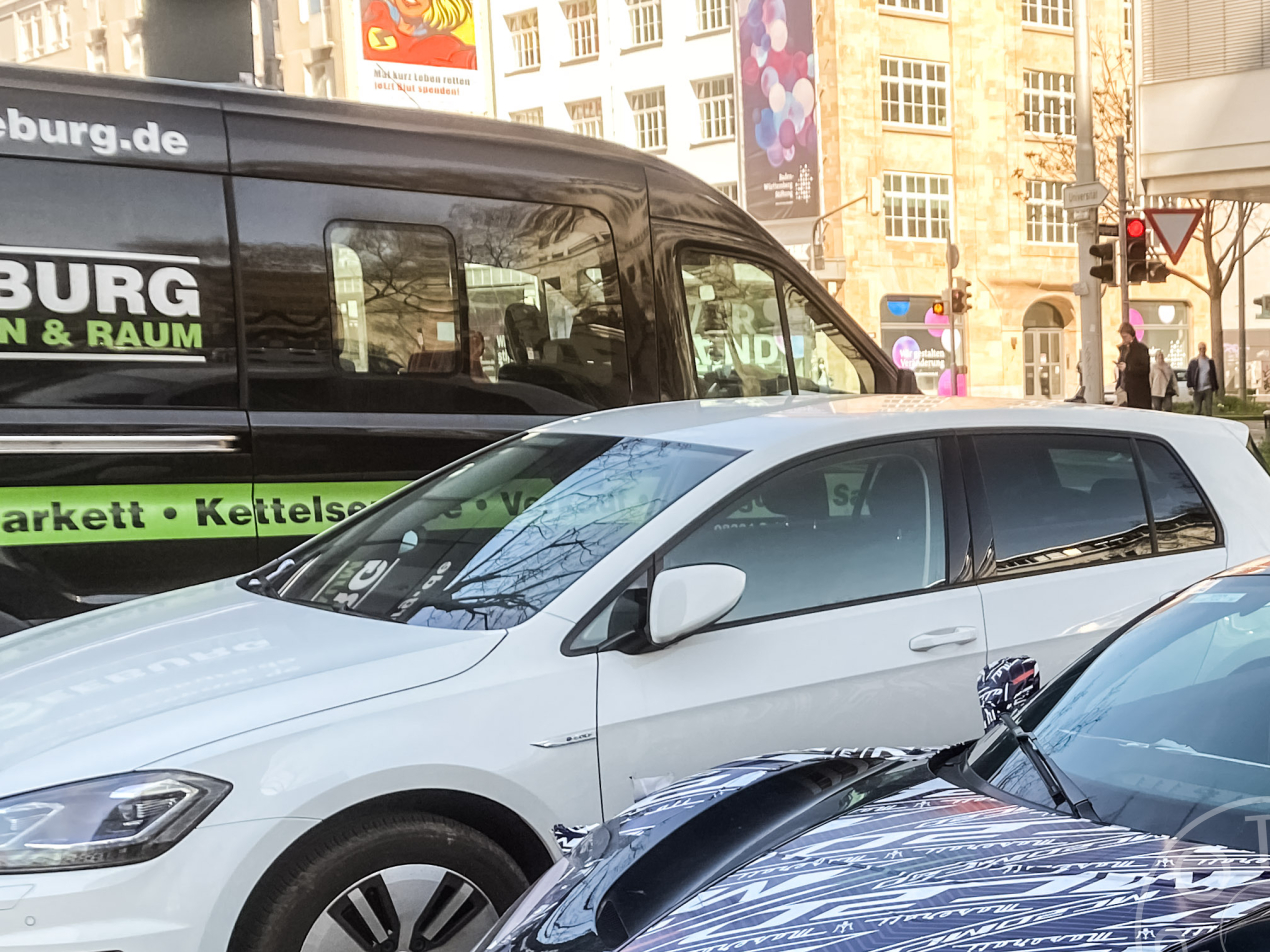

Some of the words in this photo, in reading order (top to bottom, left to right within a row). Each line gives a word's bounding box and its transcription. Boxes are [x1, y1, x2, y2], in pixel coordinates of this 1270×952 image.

[392, 70, 412, 82] kurz
[414, 73, 441, 84] Leben
[443, 76, 471, 87] retten
[397, 83, 415, 93] Blut
[0, 107, 190, 157] burg.de
[41, 318, 74, 346] &
[86, 319, 203, 349] RAUM
